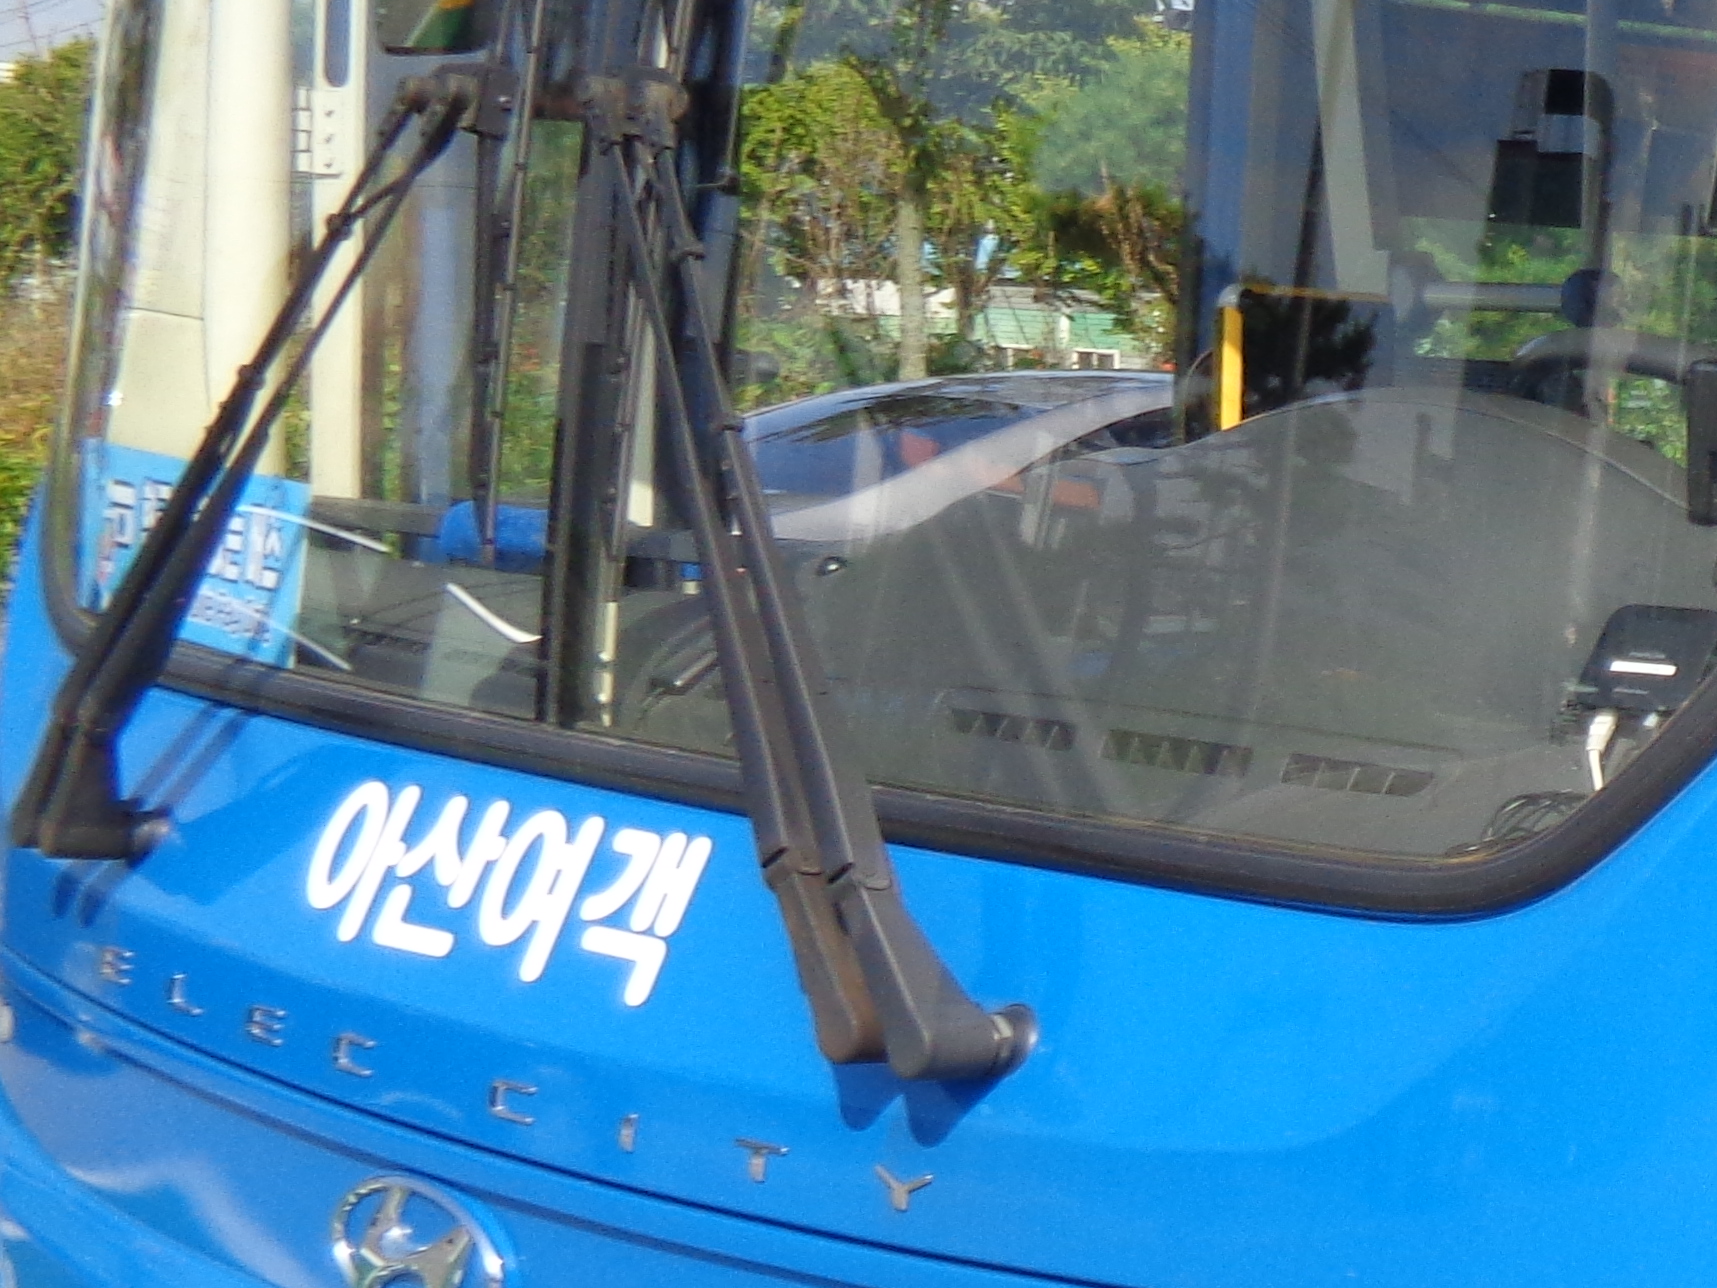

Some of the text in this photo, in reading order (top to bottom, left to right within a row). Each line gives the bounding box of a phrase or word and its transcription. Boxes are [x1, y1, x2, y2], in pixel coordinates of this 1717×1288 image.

[304, 779, 714, 1008] 아산여객
[100, 944, 934, 1212] ELEC CITY
